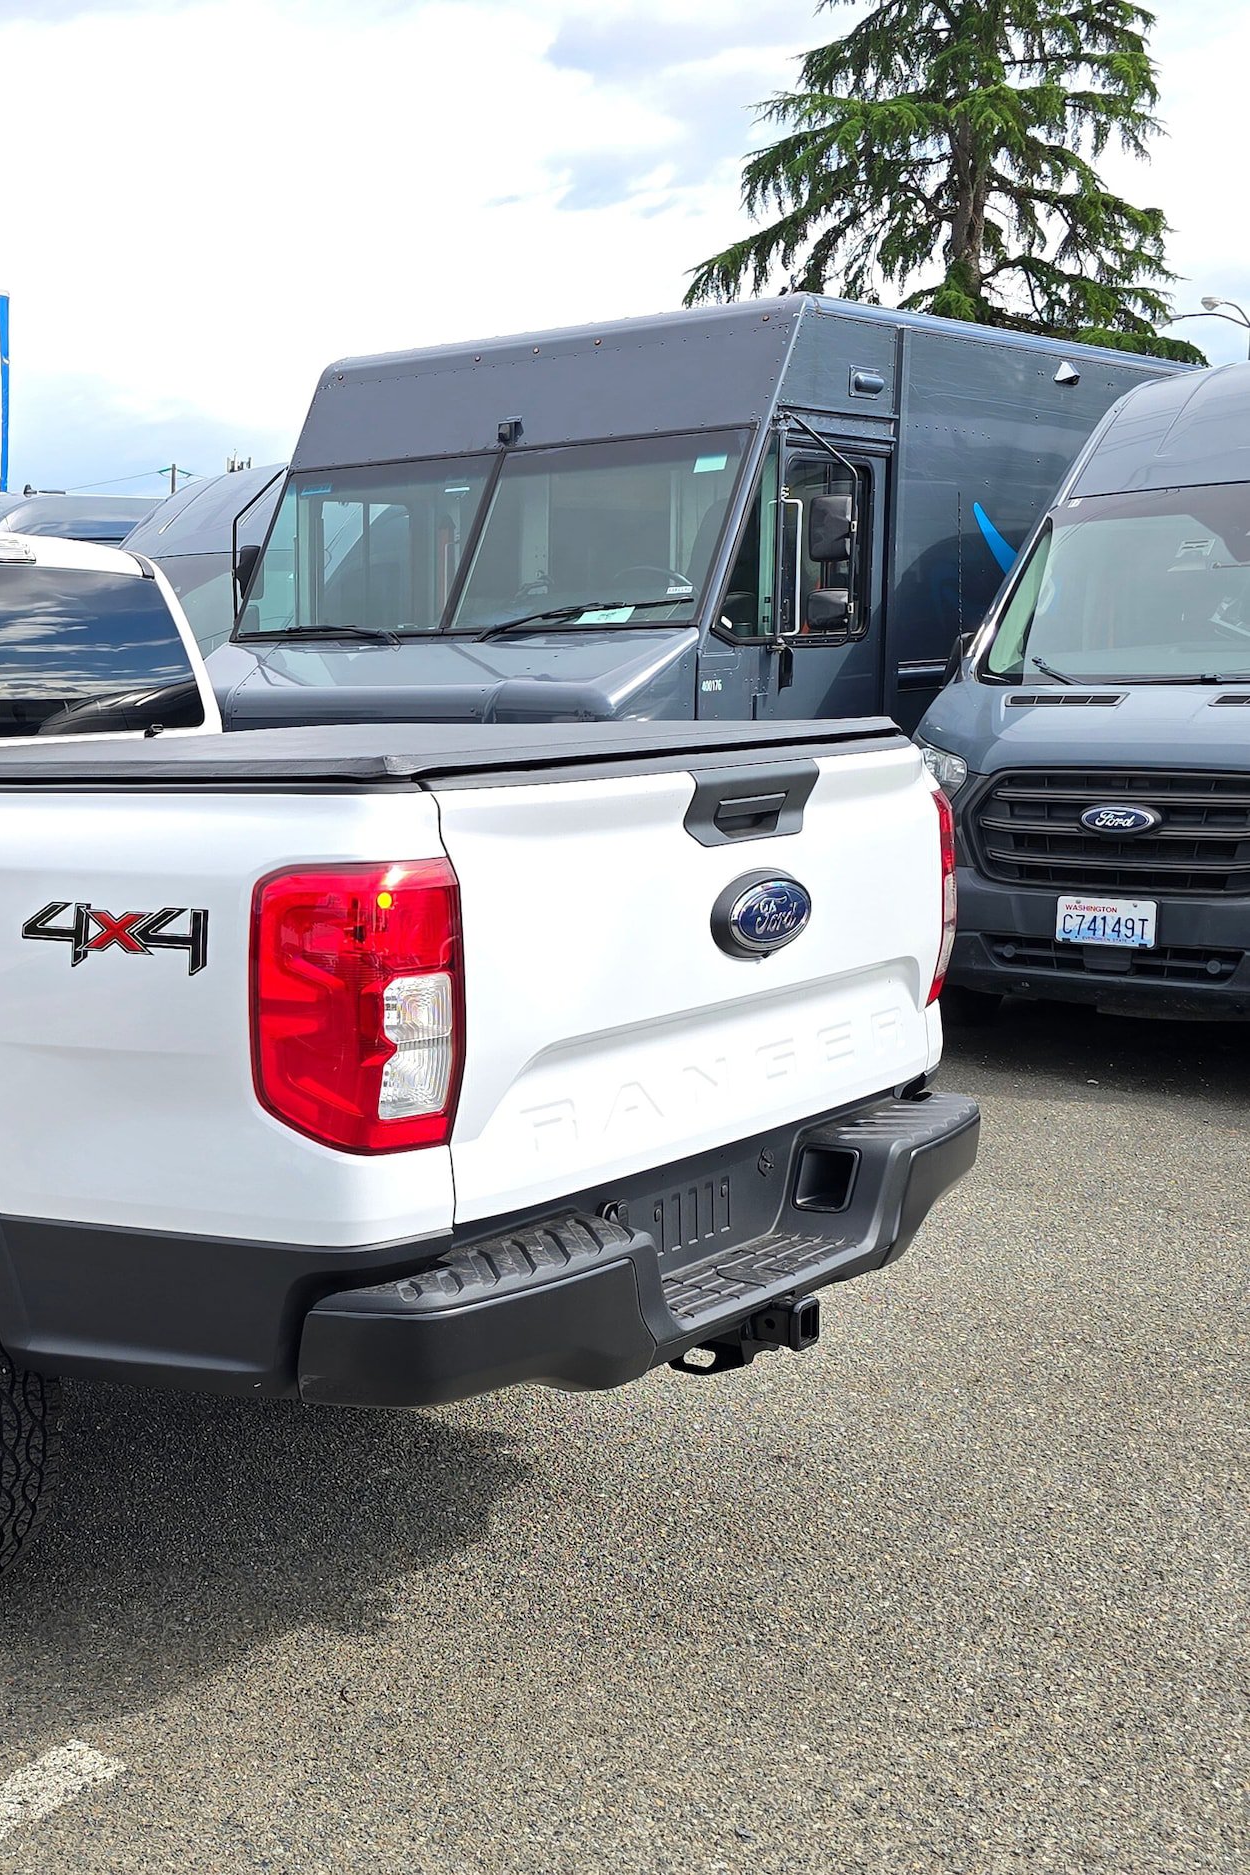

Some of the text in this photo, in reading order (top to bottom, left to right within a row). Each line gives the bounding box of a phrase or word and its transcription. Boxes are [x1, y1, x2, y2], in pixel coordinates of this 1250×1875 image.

[701, 680, 722, 691] 400176
[1095, 810, 1136, 827] Ford
[755, 895, 798, 934] Ford
[1065, 904, 1118, 913] WASHINGTON
[1062, 914, 1149, 940] C74149T
[519, 1006, 903, 1152] RANGER
